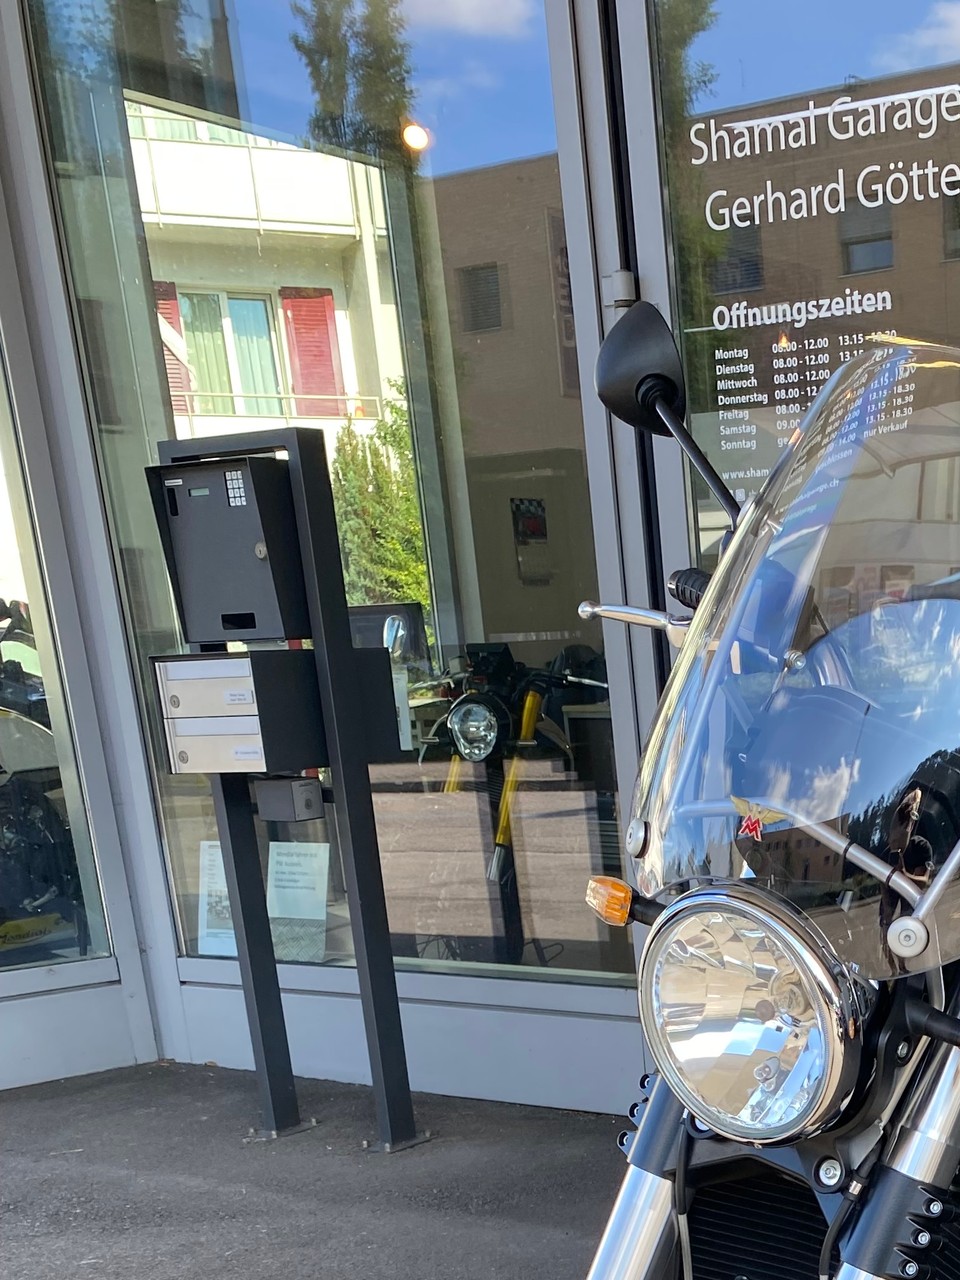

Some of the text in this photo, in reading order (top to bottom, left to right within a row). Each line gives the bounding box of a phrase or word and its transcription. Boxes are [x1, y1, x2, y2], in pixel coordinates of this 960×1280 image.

[690, 101, 816, 165] Shamal
[705, 168, 846, 231] Gerhard
[715, 348, 749, 360] Montag
[804, 338, 829, 350] 12.00
[838, 333, 864, 346] 13.15
[716, 363, 755, 376] Dienstag
[773, 357, 798, 369] 08.00
[805, 353, 830, 366] 12.00
[717, 376, 757, 391] Mittwoch
[773, 372, 799, 385] 08.00
[805, 369, 831, 381] 12.00
[718, 392, 769, 405] Donnerstag
[774, 388, 800, 400] 08.00
[893, 383, 916, 395] 18.30
[893, 395, 914, 407] 18.30
[719, 409, 749, 420] Freitag
[775, 403, 801, 415] 08.00
[892, 407, 913, 419] 18.30
[720, 424, 757, 436] Samstag
[878, 420, 908, 434] Verkauf
[721, 439, 757, 451] Sonntag
